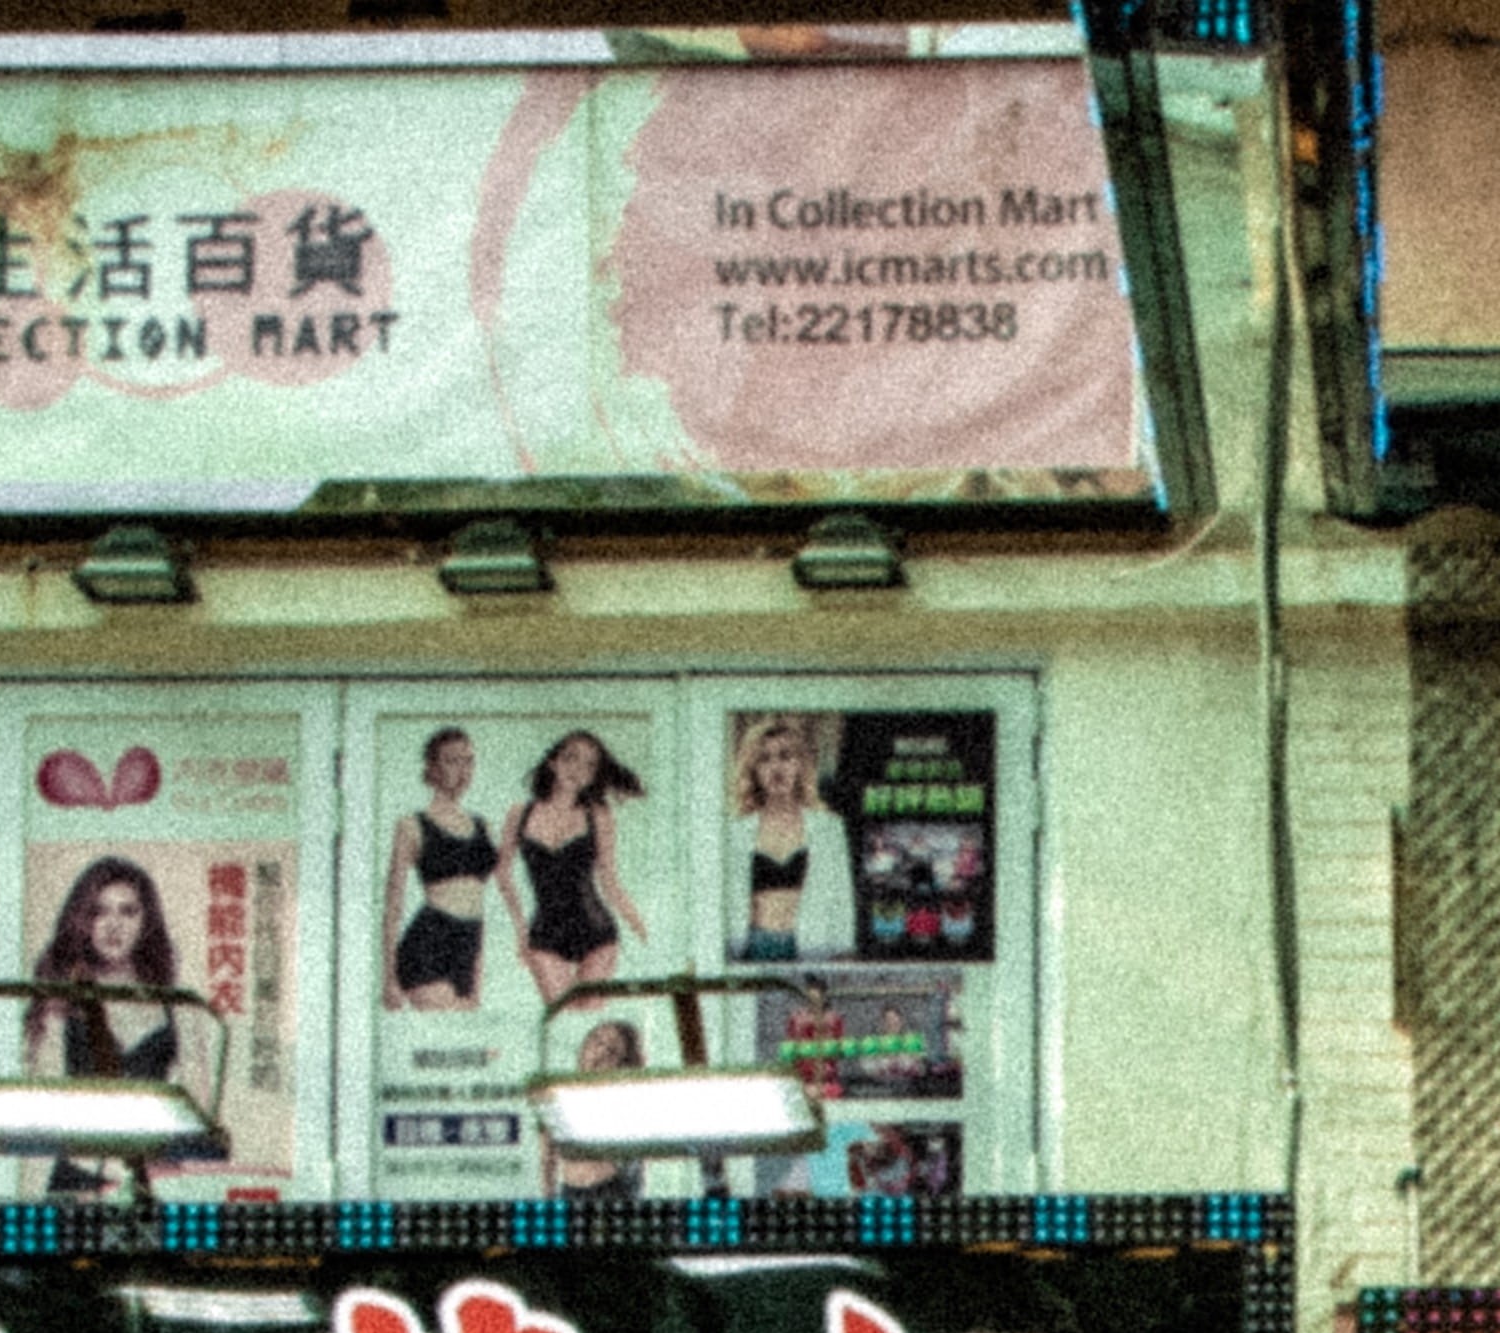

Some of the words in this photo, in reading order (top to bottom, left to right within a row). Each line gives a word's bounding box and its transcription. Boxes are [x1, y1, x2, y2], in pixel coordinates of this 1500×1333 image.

[714, 193, 757, 229] In
[769, 190, 984, 229] Collection
[997, 190, 1100, 227] Mart
[714, 246, 1108, 287] www.icmarts.com
[251, 312, 399, 359] MART
[714, 304, 1018, 344] Tel:22178838
